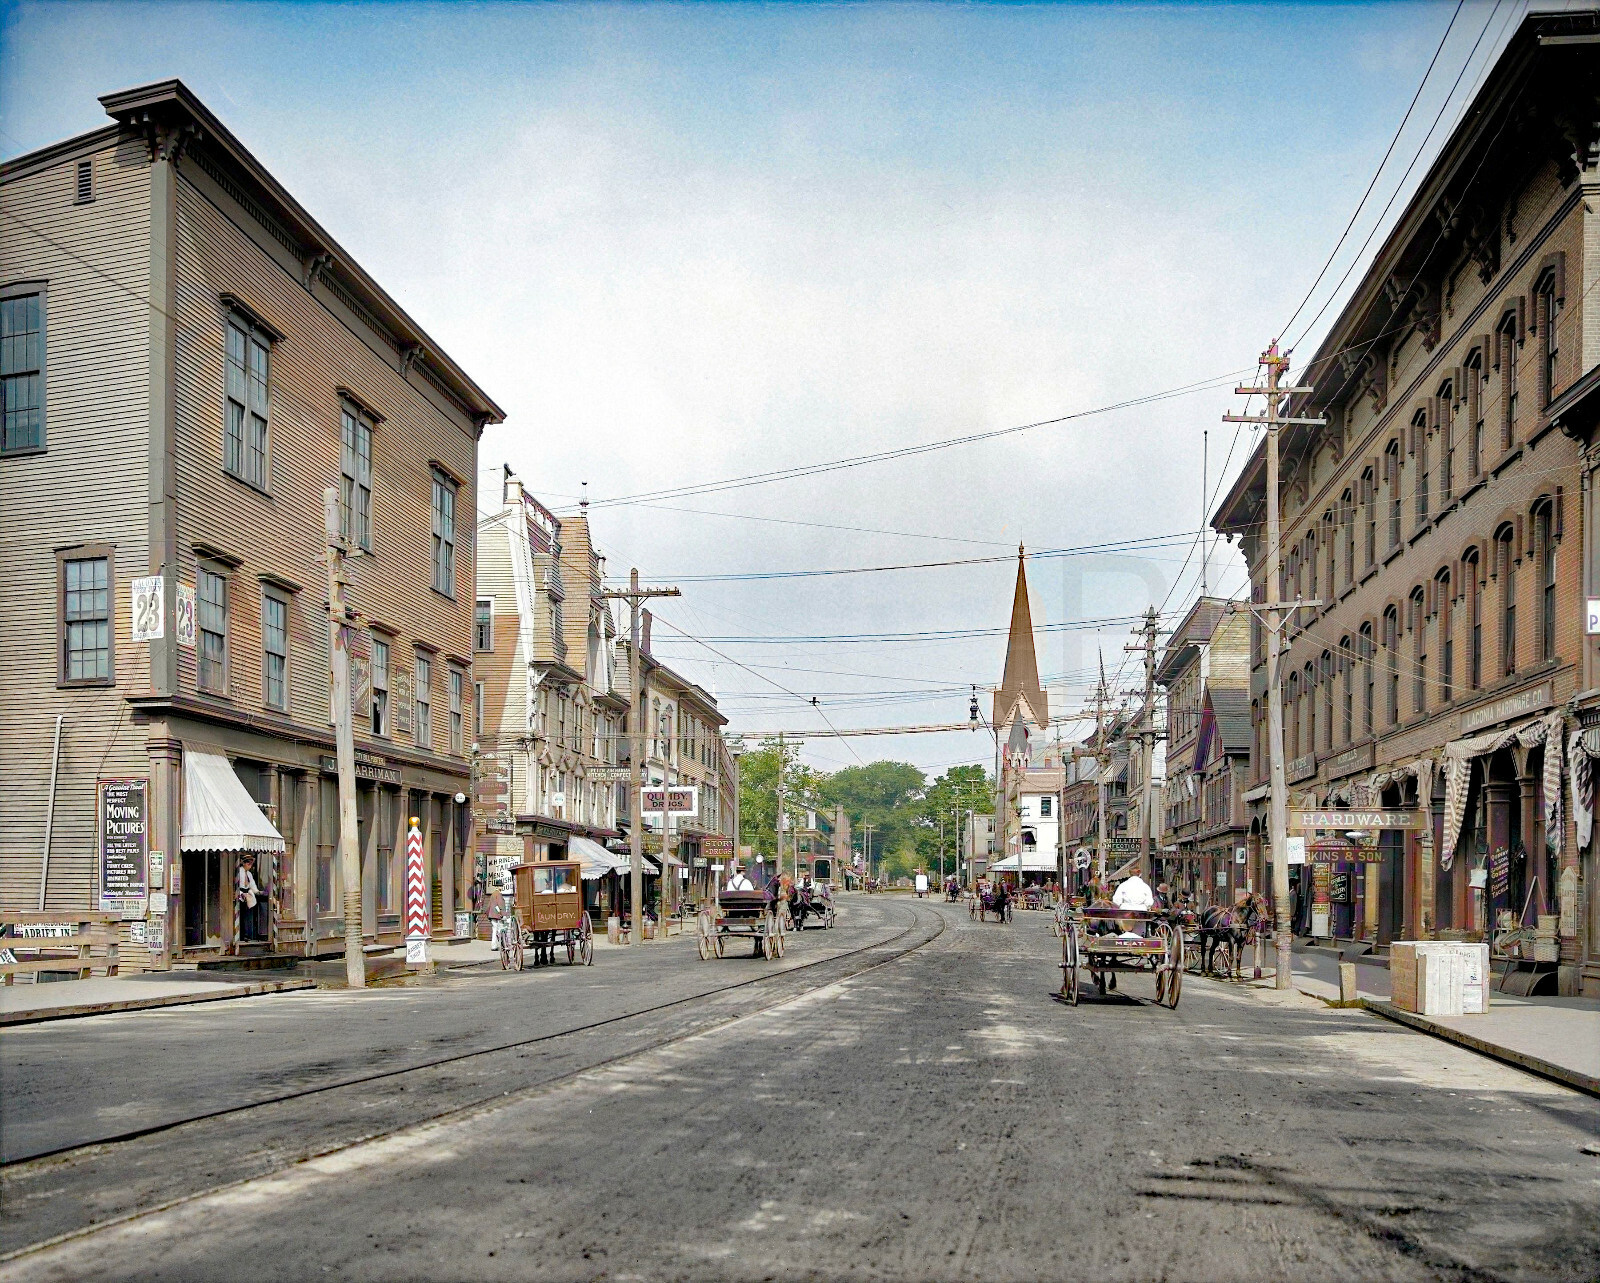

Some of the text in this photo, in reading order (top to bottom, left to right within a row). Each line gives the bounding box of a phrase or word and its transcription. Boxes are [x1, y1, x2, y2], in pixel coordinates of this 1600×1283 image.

[137, 592, 160, 632] 23
[179, 597, 193, 638] 23
[1467, 706, 1494, 727] LACONIA
[1496, 693, 1530, 718] HARDWARE
[1344, 851, 1354, 862] &
[24, 928, 71, 938] ADRIFT IN
